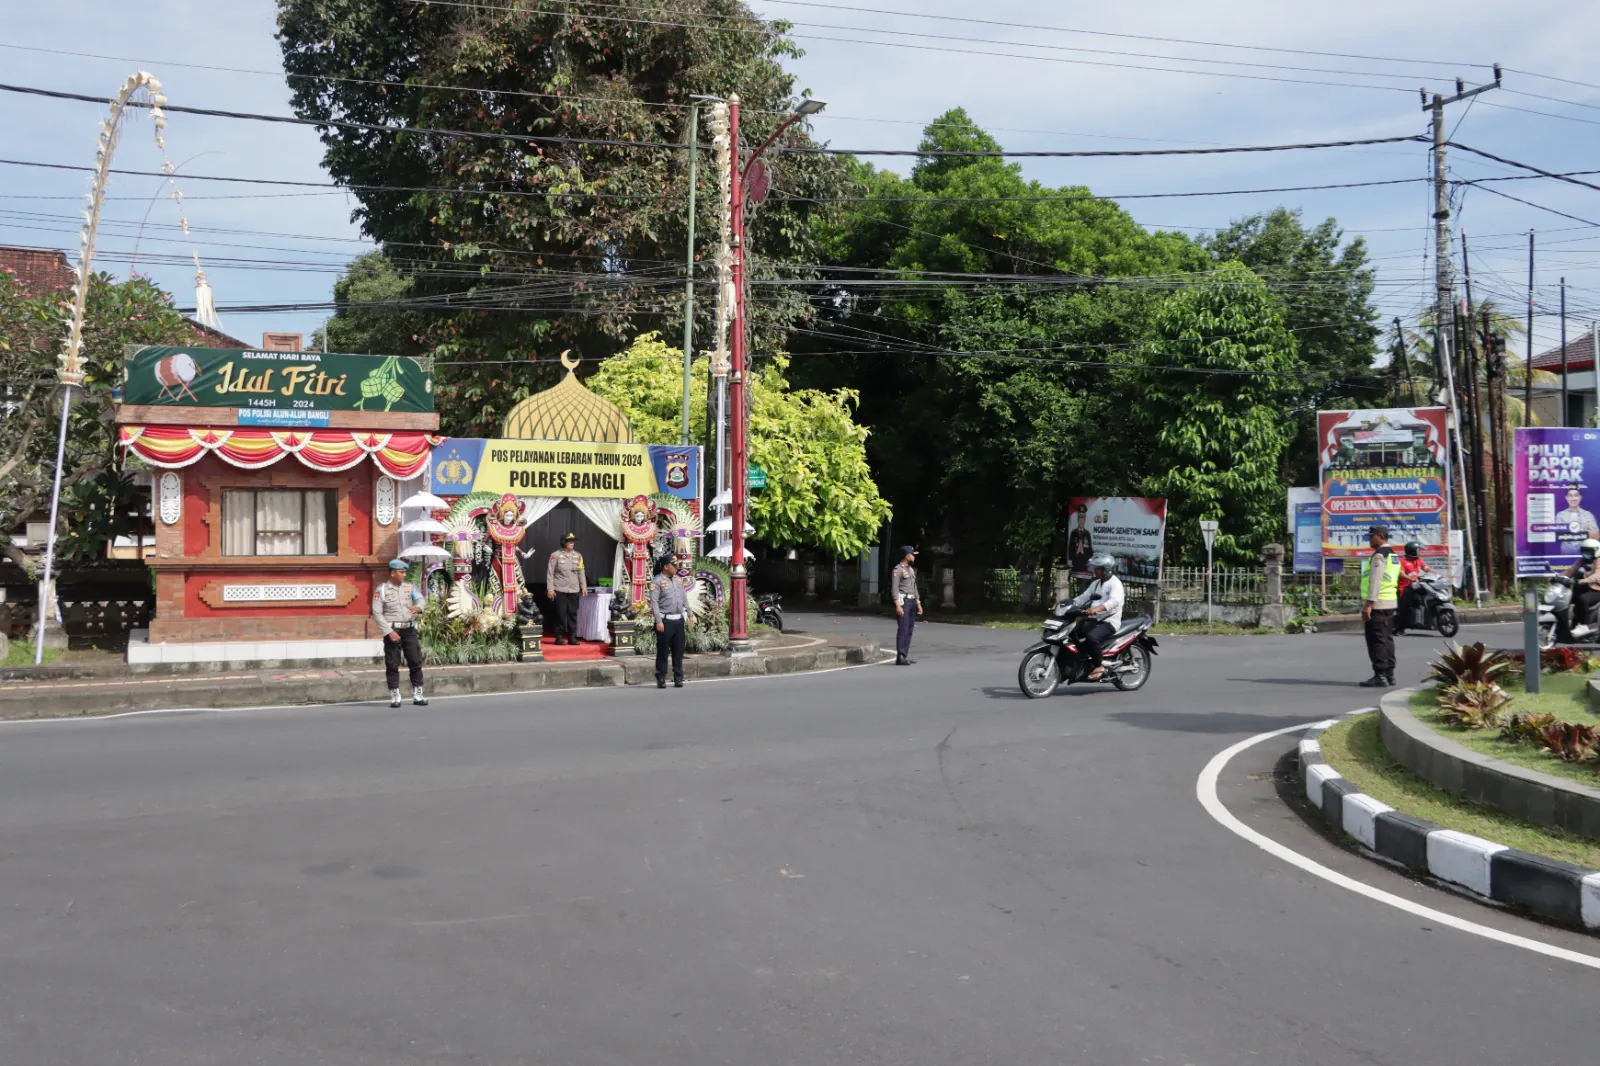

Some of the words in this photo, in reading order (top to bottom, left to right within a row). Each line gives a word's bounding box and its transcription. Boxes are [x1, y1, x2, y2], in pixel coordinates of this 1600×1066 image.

[242, 351, 278, 360] SELAMAT
[280, 353, 300, 361] HARI
[301, 354, 321, 362] RAYA
[215, 361, 275, 394] Idul
[281, 364, 347, 396] Fitri
[248, 398, 276, 407] 1445H
[293, 400, 314, 408] 2024
[239, 408, 251, 417] POS
[252, 409, 271, 418] POLISI
[272, 410, 306, 419] ALUN-ALUN
[307, 411, 329, 420] BANGLI
[1528, 444, 1570, 456] PILIH
[491, 449, 508, 463] POS
[510, 450, 554, 464] PELAYANAN
[557, 452, 592, 465] LEBARAN
[594, 453, 620, 466] TAHUN
[622, 454, 642, 467] 2024
[1528, 456, 1584, 469] LAPOR
[509, 470, 566, 489] POLRES
[570, 472, 625, 490] BANGLI
[1331, 469, 1383, 480] POLRES
[1386, 467, 1436, 478] BANGLI
[1528, 469, 1584, 482] PAJAK
[1346, 482, 1421, 492] MELAKSANAKAN
[1330, 500, 1345, 511] OPS
[1345, 499, 1393, 511] KESELAMATAN
[1394, 498, 1418, 510] AGUNG
[1419, 498, 1437, 509] 2024
[1142, 528, 1160, 537] SAMI
